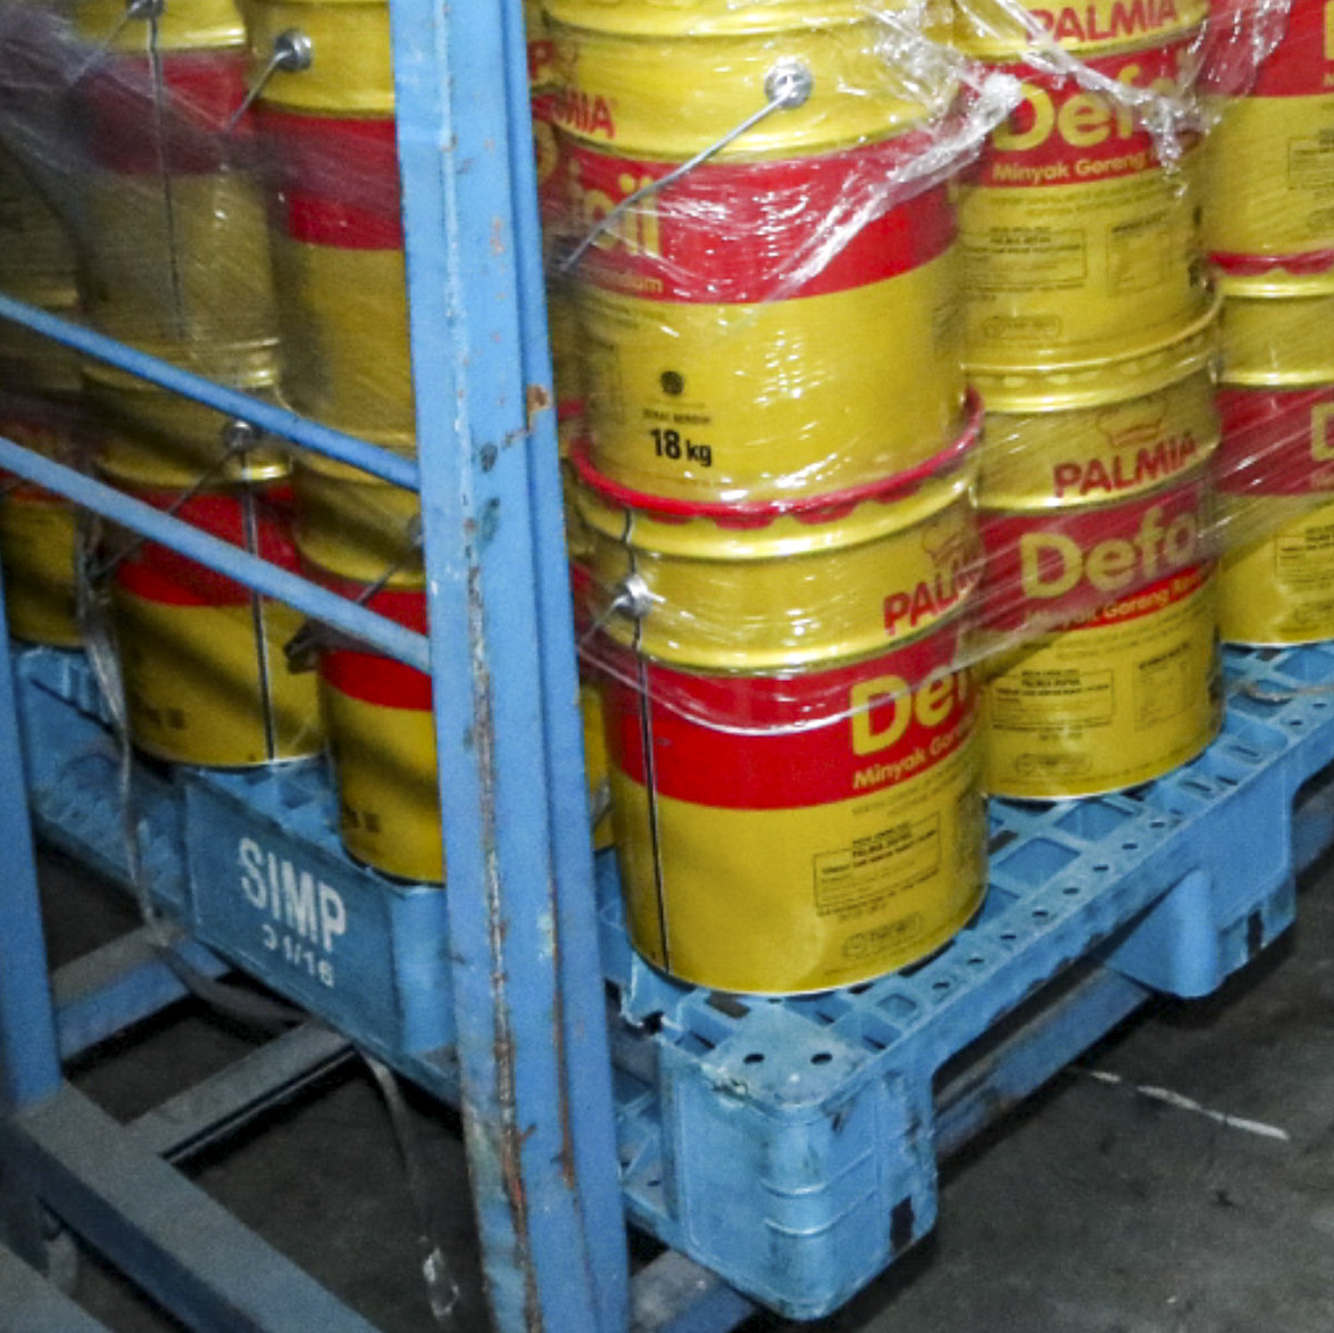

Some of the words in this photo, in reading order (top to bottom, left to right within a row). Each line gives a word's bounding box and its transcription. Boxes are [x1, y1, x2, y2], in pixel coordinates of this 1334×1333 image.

[992, 63, 1177, 152] Def
[992, 162, 1069, 186] Minyak
[1074, 152, 1147, 177] Goreng
[650, 427, 681, 460] 18
[685, 439, 712, 467] kg
[1053, 431, 1196, 498] PALMIA
[1020, 504, 1197, 599] Defo
[853, 746, 927, 790] Minyak
[239, 836, 347, 953] SIMP
